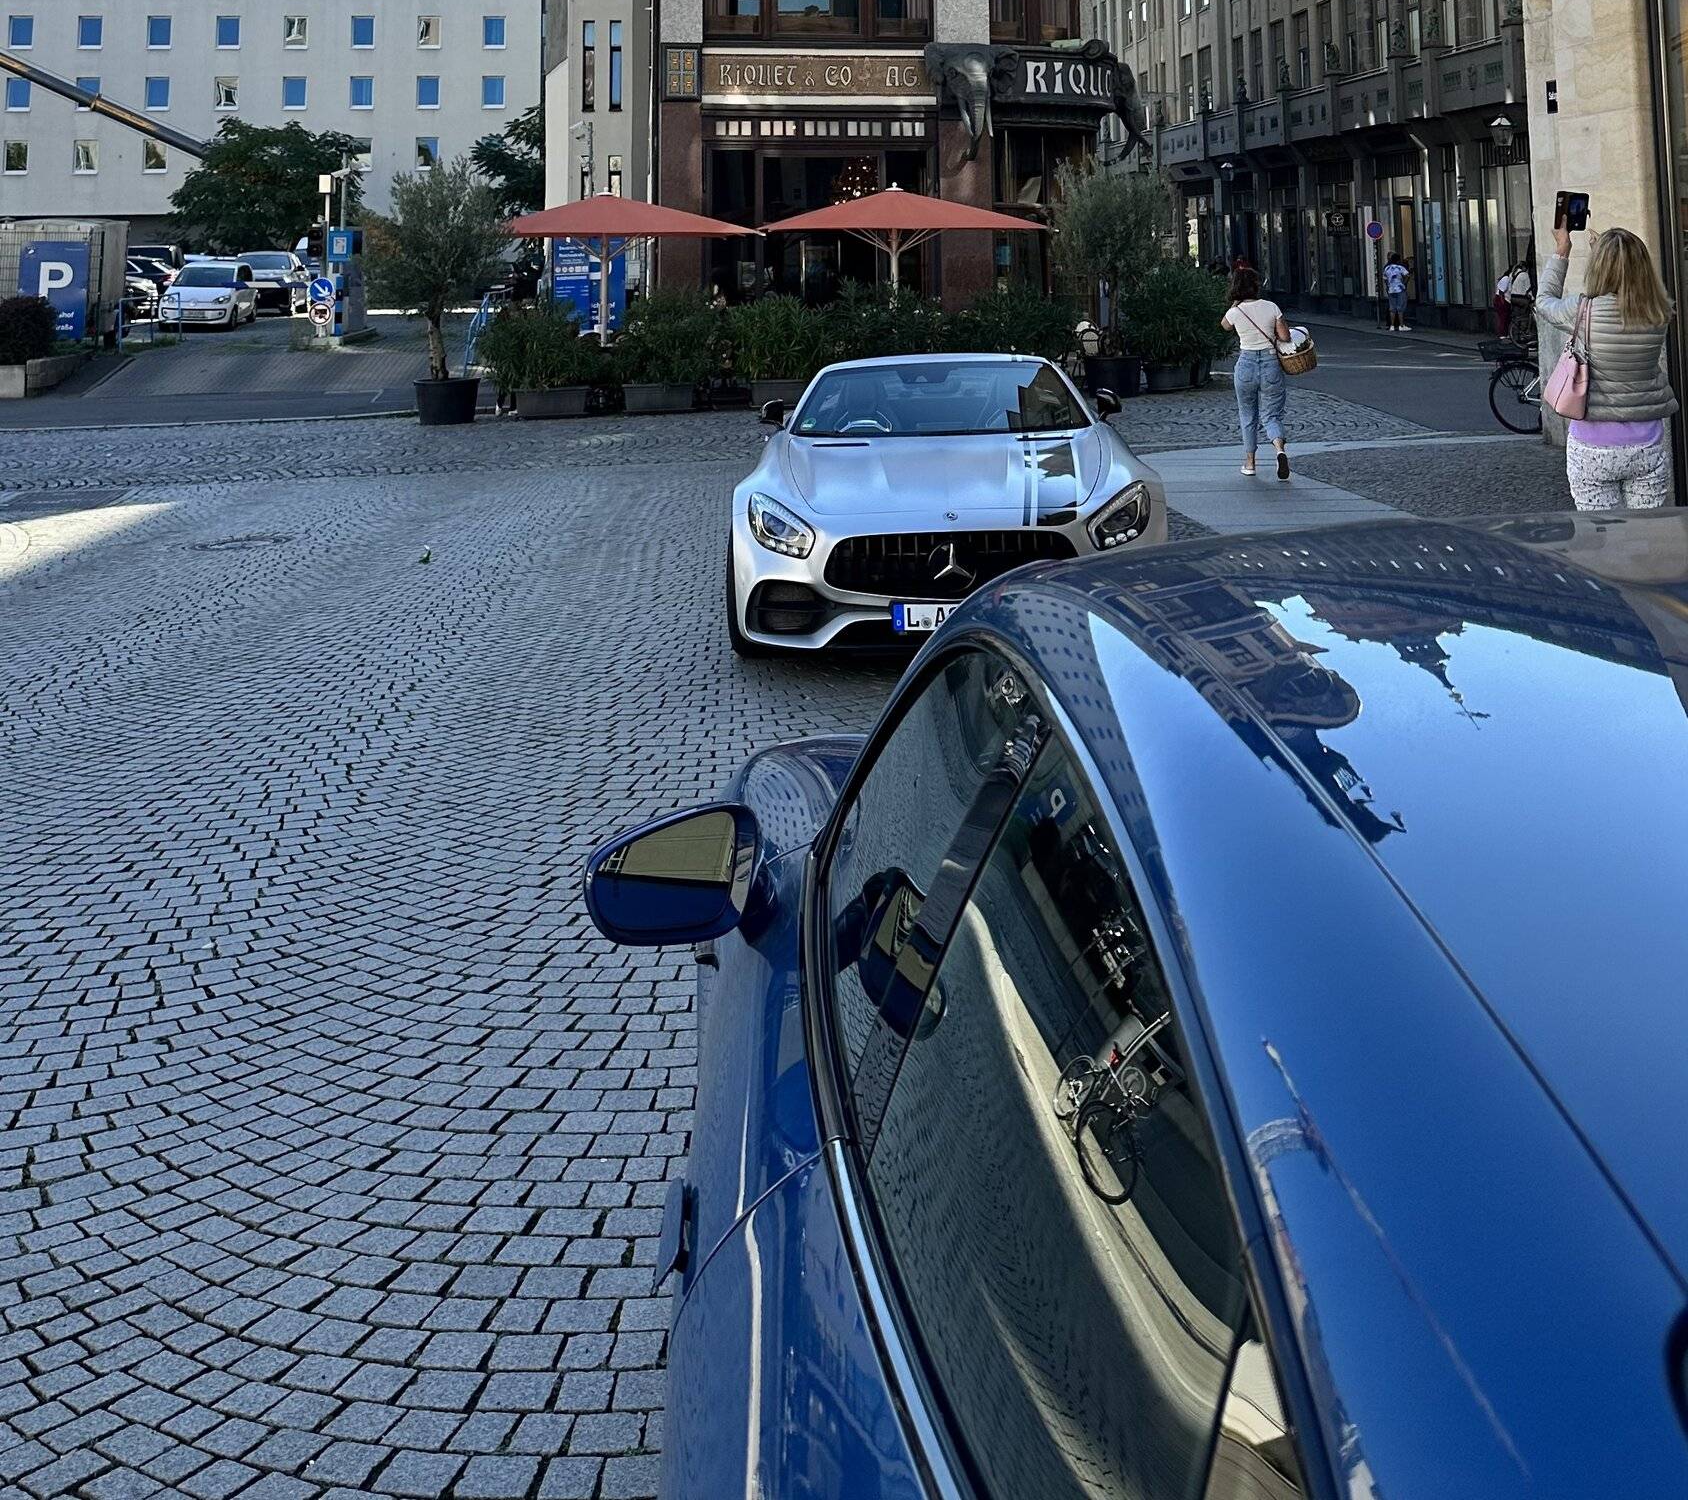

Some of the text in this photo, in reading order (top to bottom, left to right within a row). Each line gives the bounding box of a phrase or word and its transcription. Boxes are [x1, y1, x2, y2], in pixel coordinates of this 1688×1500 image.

[804, 70, 815, 87] &
[38, 261, 74, 299] P
[906, 607, 920, 627] L
